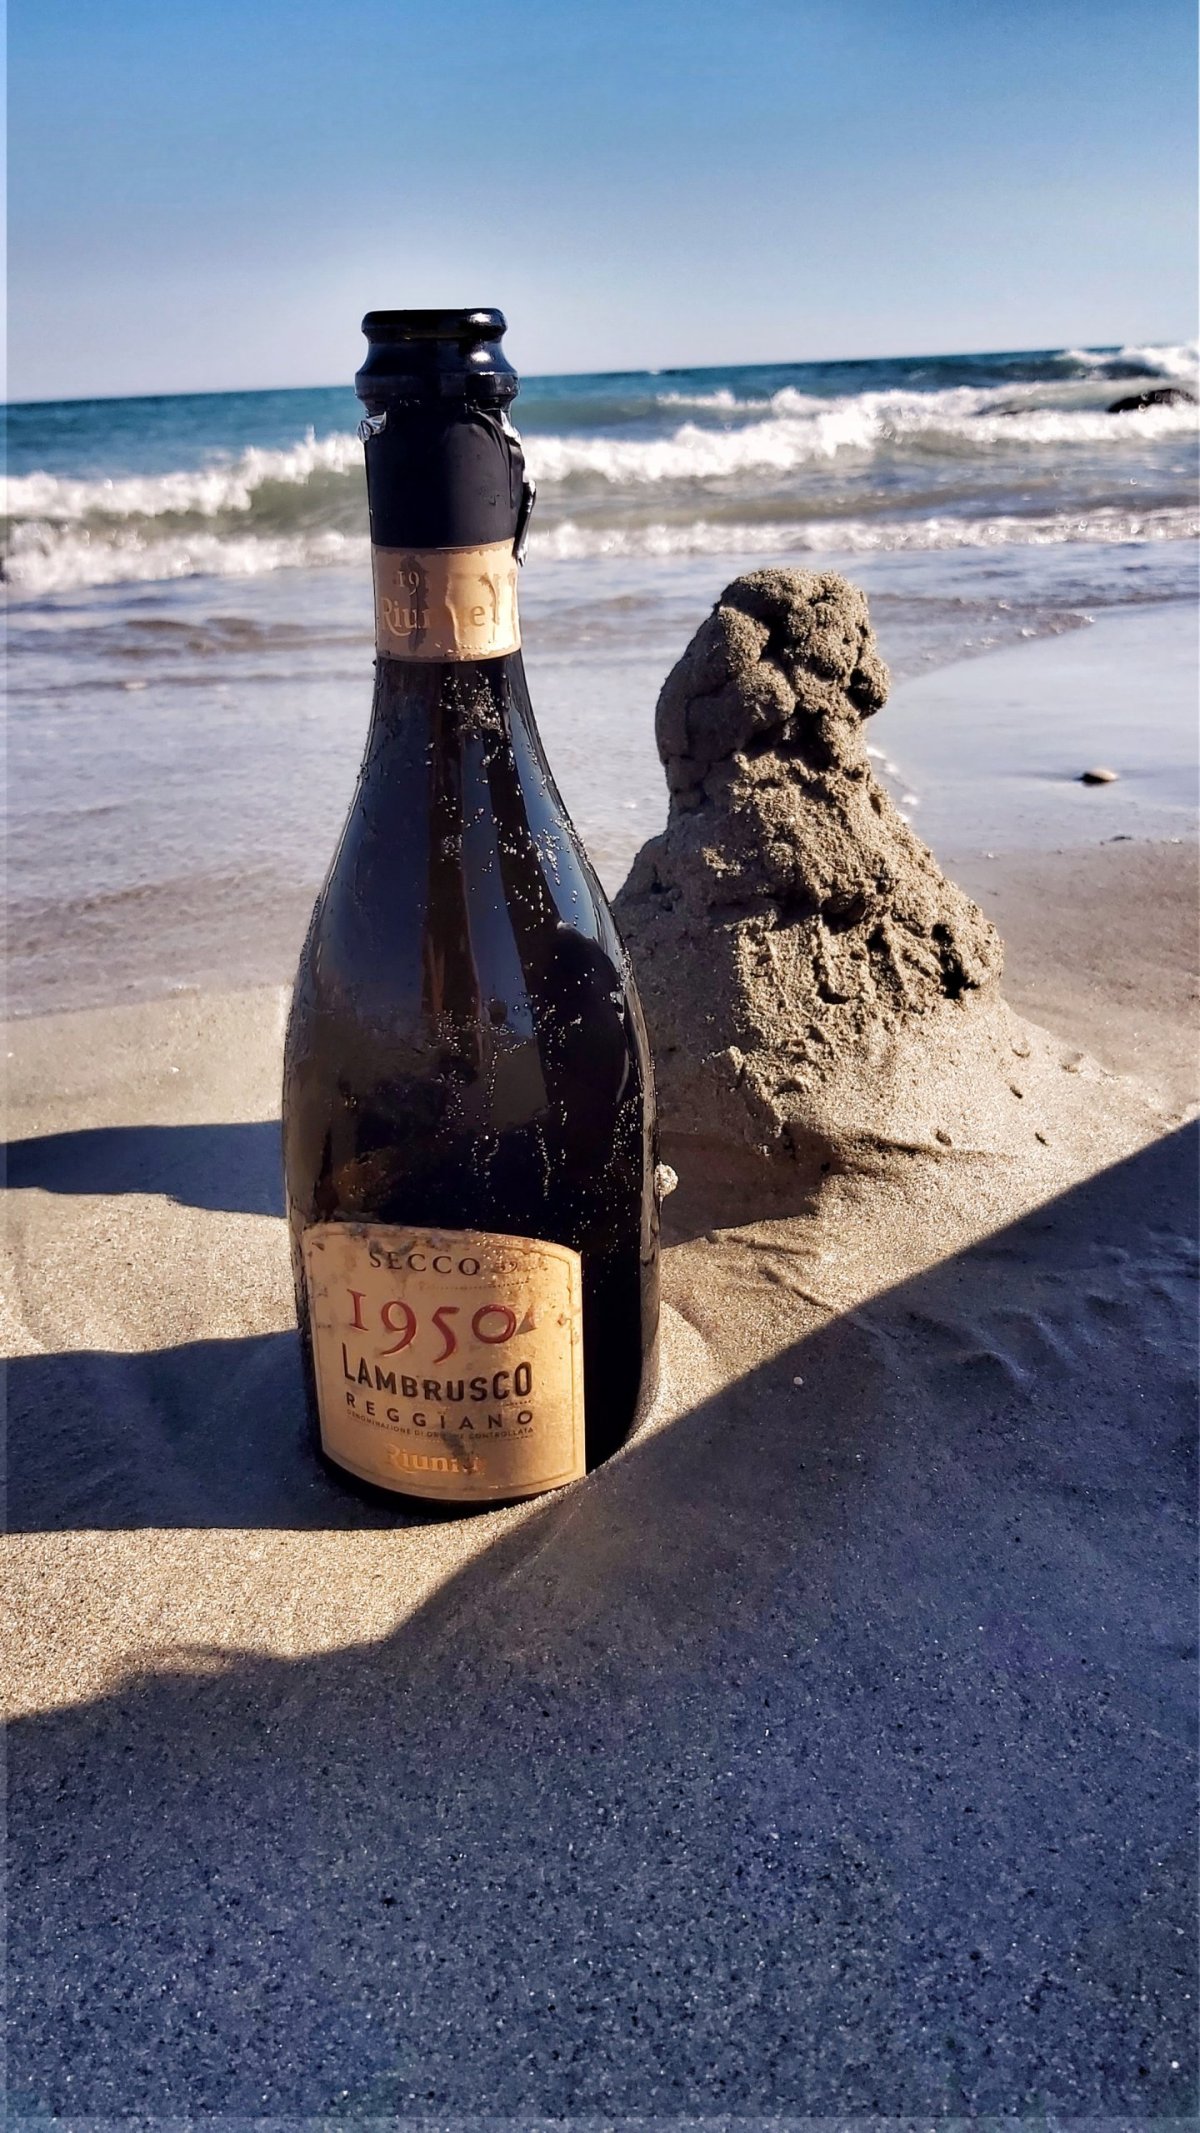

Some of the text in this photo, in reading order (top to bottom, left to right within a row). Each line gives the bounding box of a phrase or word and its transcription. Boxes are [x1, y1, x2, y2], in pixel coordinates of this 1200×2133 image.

[397, 570, 420, 596] 19
[369, 1252, 481, 1276] SECCO
[347, 1288, 517, 1364] 1950
[342, 1342, 532, 1401] LAMBRUSCO
[346, 1391, 533, 1430] REGGIANO
